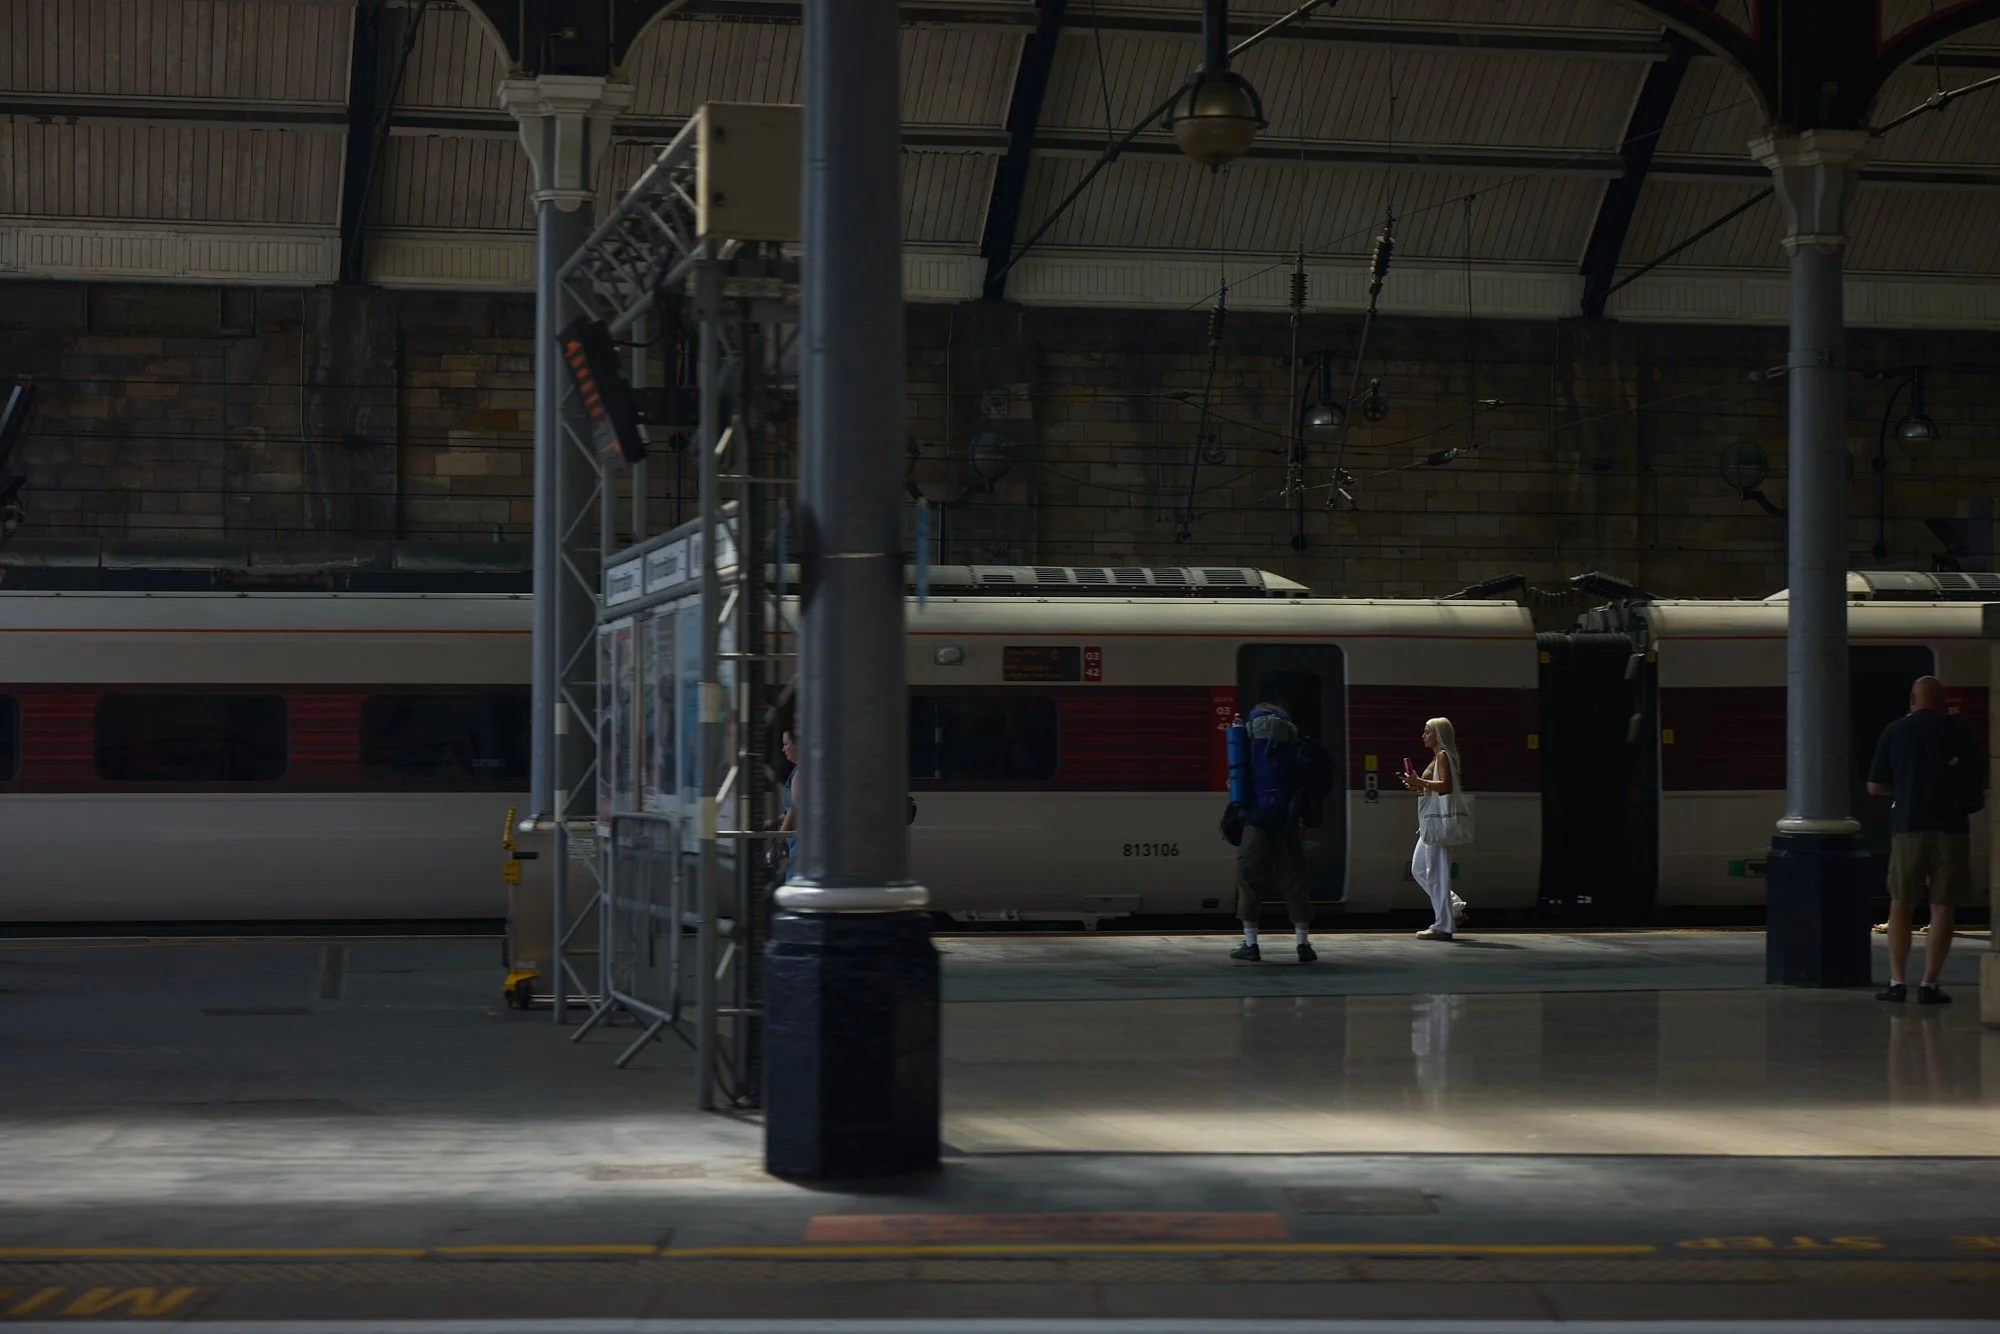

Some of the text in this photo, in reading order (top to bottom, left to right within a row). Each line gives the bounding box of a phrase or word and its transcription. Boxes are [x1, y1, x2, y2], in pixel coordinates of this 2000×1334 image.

[1085, 651, 1101, 661] 03
[1084, 667, 1101, 677] 42
[1215, 705, 1231, 715] 03
[1123, 843, 1179, 857] 813106
[1676, 1235, 1888, 1251] STEP
